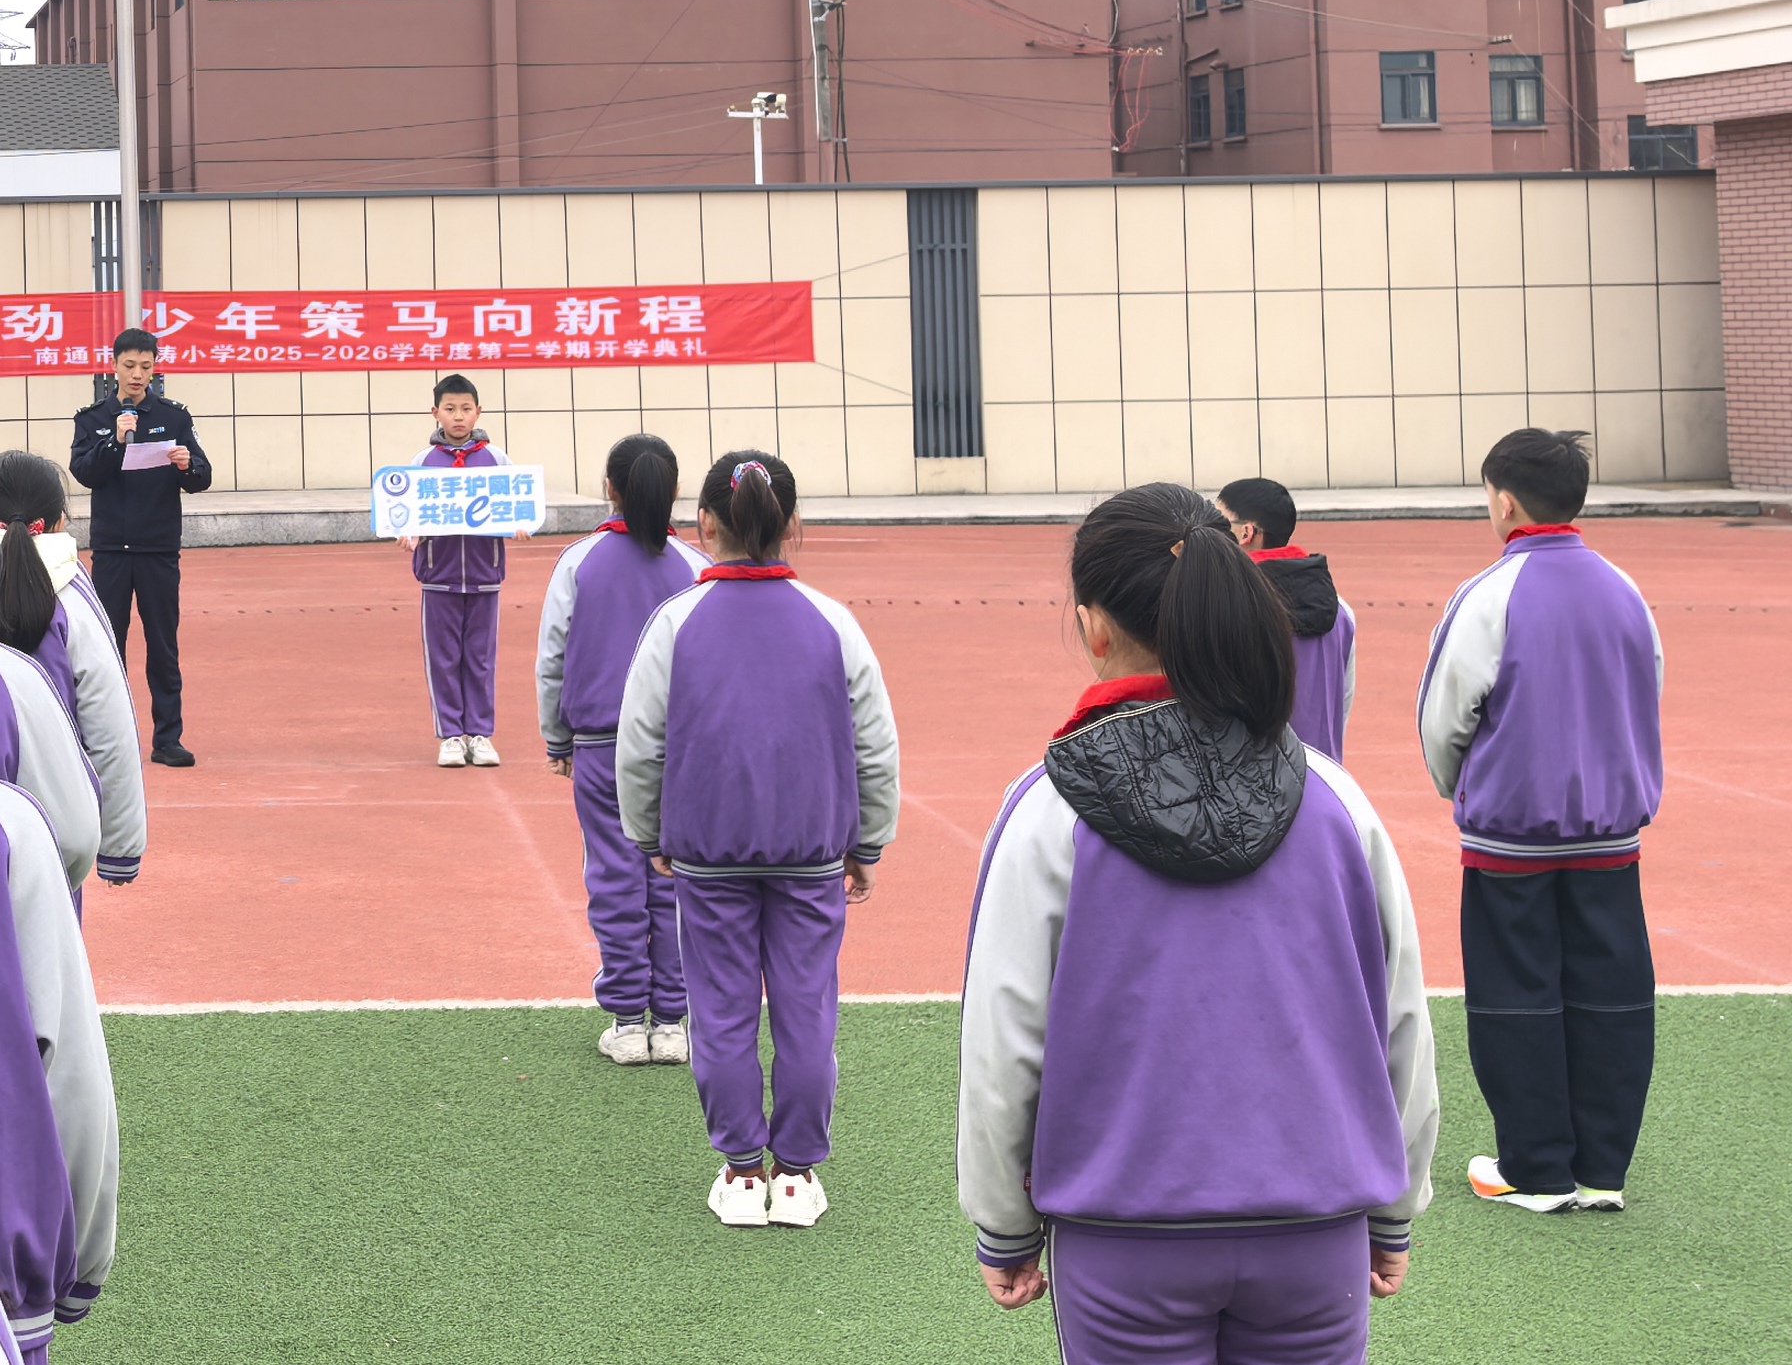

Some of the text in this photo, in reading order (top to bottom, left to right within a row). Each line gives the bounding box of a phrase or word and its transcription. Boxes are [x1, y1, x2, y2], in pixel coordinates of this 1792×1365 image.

[141, 295, 707, 340] 少年策马向新程
[419, 495, 536, 528] 共治e空间
